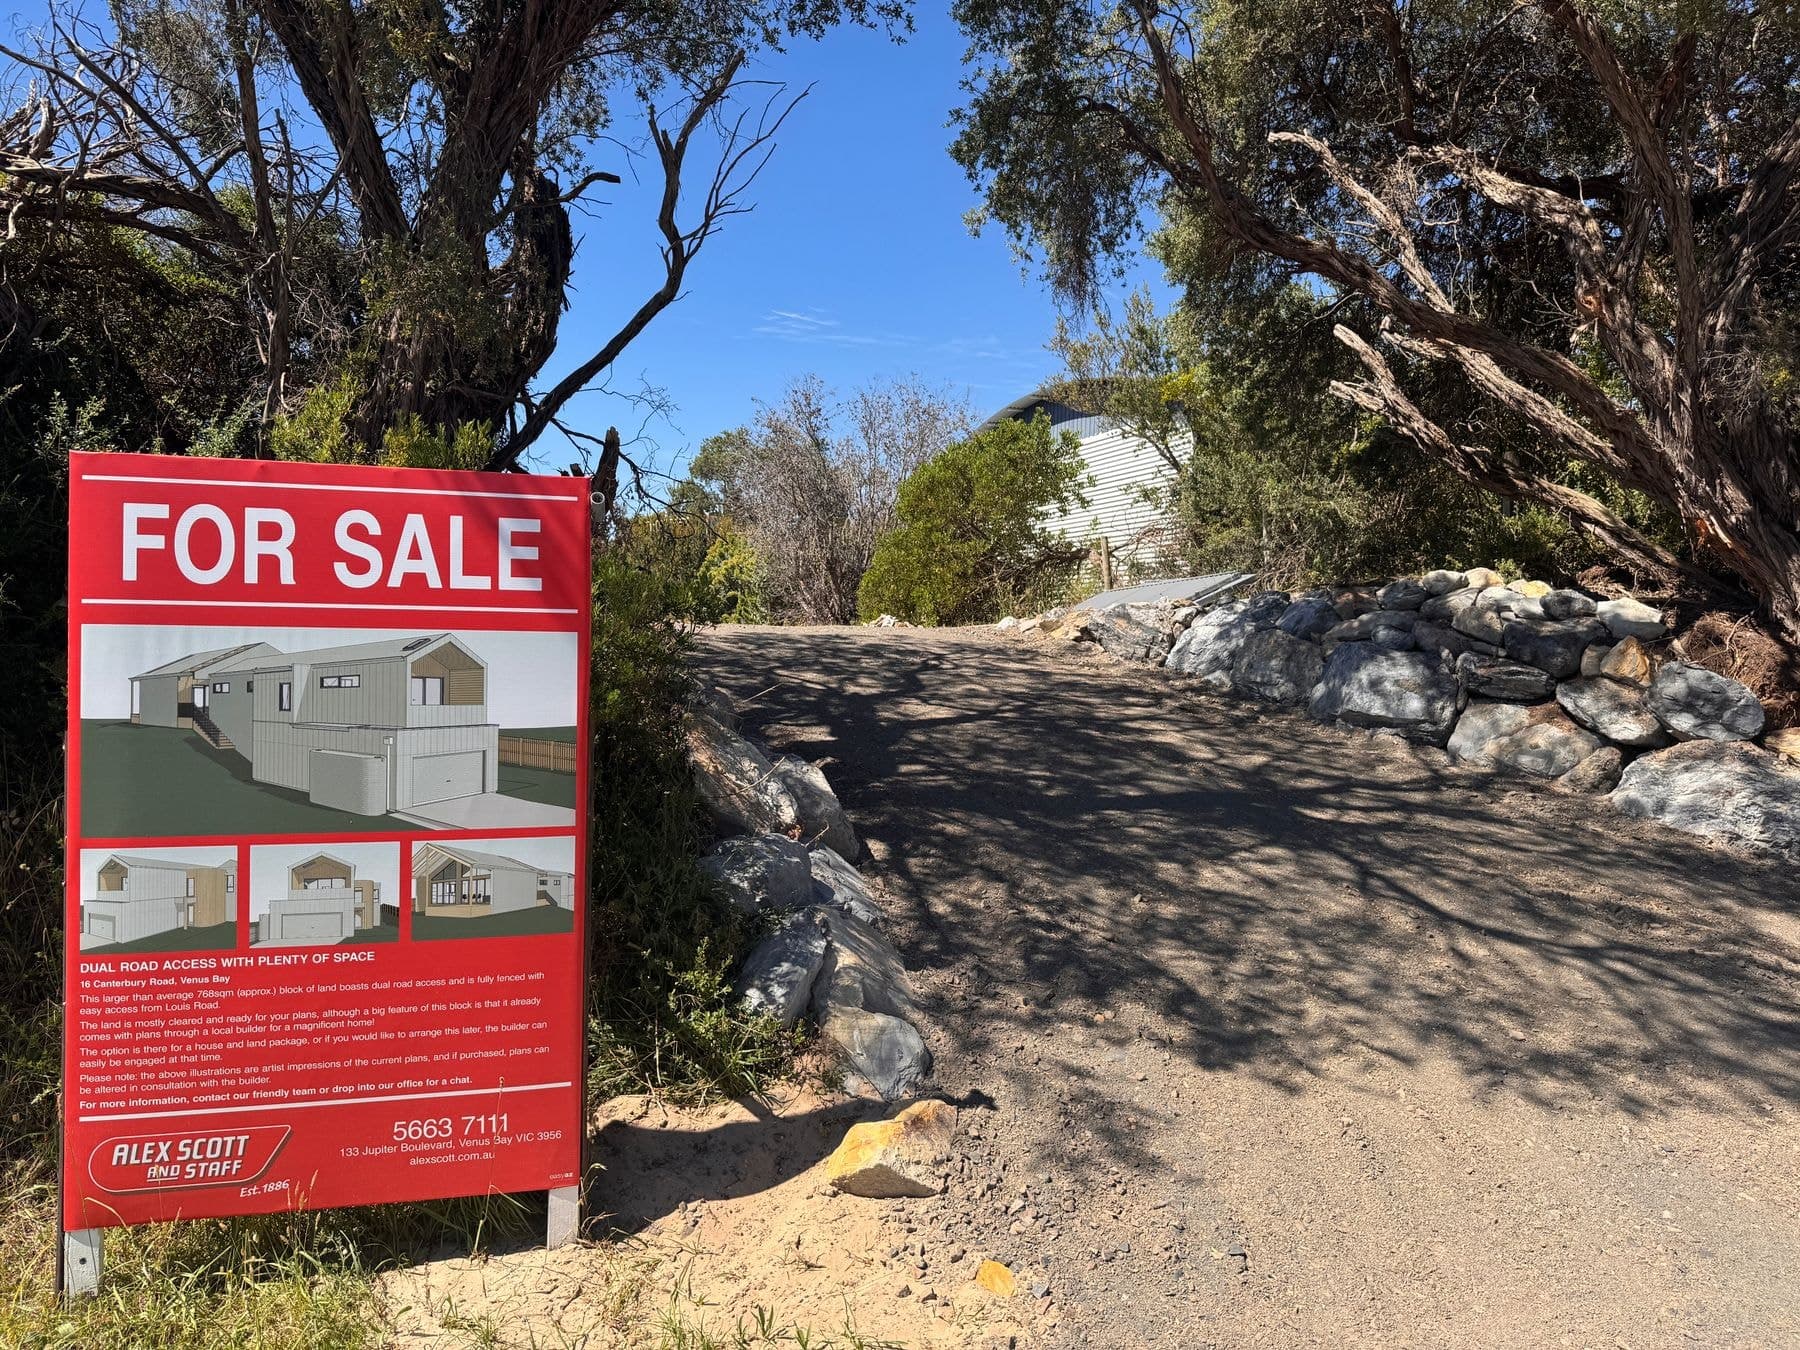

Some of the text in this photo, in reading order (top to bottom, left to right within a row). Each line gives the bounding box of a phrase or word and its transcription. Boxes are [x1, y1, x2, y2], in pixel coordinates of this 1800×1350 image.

[122, 502, 541, 590] FOR SALE
[80, 950, 375, 974] DUAL ROAD ACCESS WITH PLENTY OF SPACE
[79, 971, 544, 1004] This larger than average 768sqm (approx.) block of land boasts dual road access and is fully fenced with
[80, 974, 230, 988] 16 Canterbury Road, Venus Bay
[79, 1000, 220, 1016] easy access from Louis Road.
[79, 1020, 98, 1030] The
[100, 1020, 121, 1029] land
[123, 1019, 132, 1028] is
[134, 1018, 166, 1028] mostly
[168, 1016, 203, 1026] cleared
[205, 1014, 224, 1024] and
[226, 1013, 252, 1024] ready
[255, 1012, 267, 1021] for
[269, 1012, 290, 1022] your
[292, 1010, 319, 1021] plans,
[322, 1007, 360, 1018] although
[371, 1006, 385, 1016] big
[387, 1005, 418, 1014] feature
[420, 1003, 429, 1012] of
[431, 1002, 447, 1011] this
[449, 1000, 472, 1010] block
[474, 1000, 482, 1009] is
[484, 999, 502, 1008] that
[510, 996, 541, 1006] already
[79, 1033, 111, 1042] comes
[113, 1031, 132, 1040] with
[135, 1030, 161, 1041] plans
[163, 1027, 199, 1038] through
[211, 1025, 233, 1035] local
[235, 1024, 267, 1034] builder
[269, 1023, 282, 1032] for
[293, 1019, 345, 1031] magnificent
[346, 1017, 375, 1027] home!
[79, 1047, 98, 1056] The
[100, 1046, 130, 1057] option
[132, 1046, 140, 1054] is
[143, 1045, 168, 1054] there
[170, 1043, 183, 1052] for
[194, 1042, 223, 1050] house
[226, 1039, 244, 1049] and
[246, 1038, 266, 1048] land
[268, 1037, 310, 1048] package,
[324, 1034, 330, 1043] if
[332, 1034, 349, 1044] you
[351, 1031, 378, 1041] would
[380, 1031, 395, 1040] like
[408, 1029, 442, 1038] arrange
[444, 1026, 460, 1035] this
[462, 1025, 482, 1034] later,
[484, 1024, 499, 1032] the
[500, 1022, 530, 1032] builder
[531, 1021, 547, 1029] can
[79, 1053, 222, 1068] easily be engaged at that time.
[79, 1074, 112, 1083] Please
[114, 1072, 138, 1081] note:
[140, 1071, 156, 1080] the
[158, 1070, 187, 1079] above
[189, 1066, 242, 1077] illustrations
[261, 1063, 284, 1073] artist
[286, 1060, 341, 1071] impressions
[343, 1058, 352, 1067] of
[354, 1058, 369, 1066] the
[371, 1055, 402, 1065] current
[404, 1054, 430, 1064] plans,
[432, 1051, 450, 1061] and
[451, 1051, 458, 1059] if
[459, 1048, 507, 1060] purchased,
[508, 1047, 532, 1057] plans
[79, 1075, 271, 1095] be altered in consultation with the builder.
[79, 1100, 97, 1109] For
[99, 1100, 126, 1108] more
[128, 1095, 190, 1107] information,
[192, 1092, 230, 1102] contact
[232, 1092, 250, 1100] our
[252, 1088, 290, 1099] friendly
[292, 1087, 316, 1096] team
[331, 1084, 355, 1094] drop
[357, 1082, 376, 1091] into
[396, 1079, 424, 1088] office
[425, 1078, 439, 1086] for
[449, 1075, 473, 1085] chat.
[393, 1113, 508, 1140] 5663 7111
[111, 1136, 250, 1166] ALEX SCOTT
[340, 1129, 562, 1157] 133 Jupiter Boulevard, Venus Bay VIC 3956
[147, 1160, 242, 1179] AND STAFF
[409, 1151, 495, 1166] alexscott.com.au
[240, 1180, 290, 1198] Est.1886
